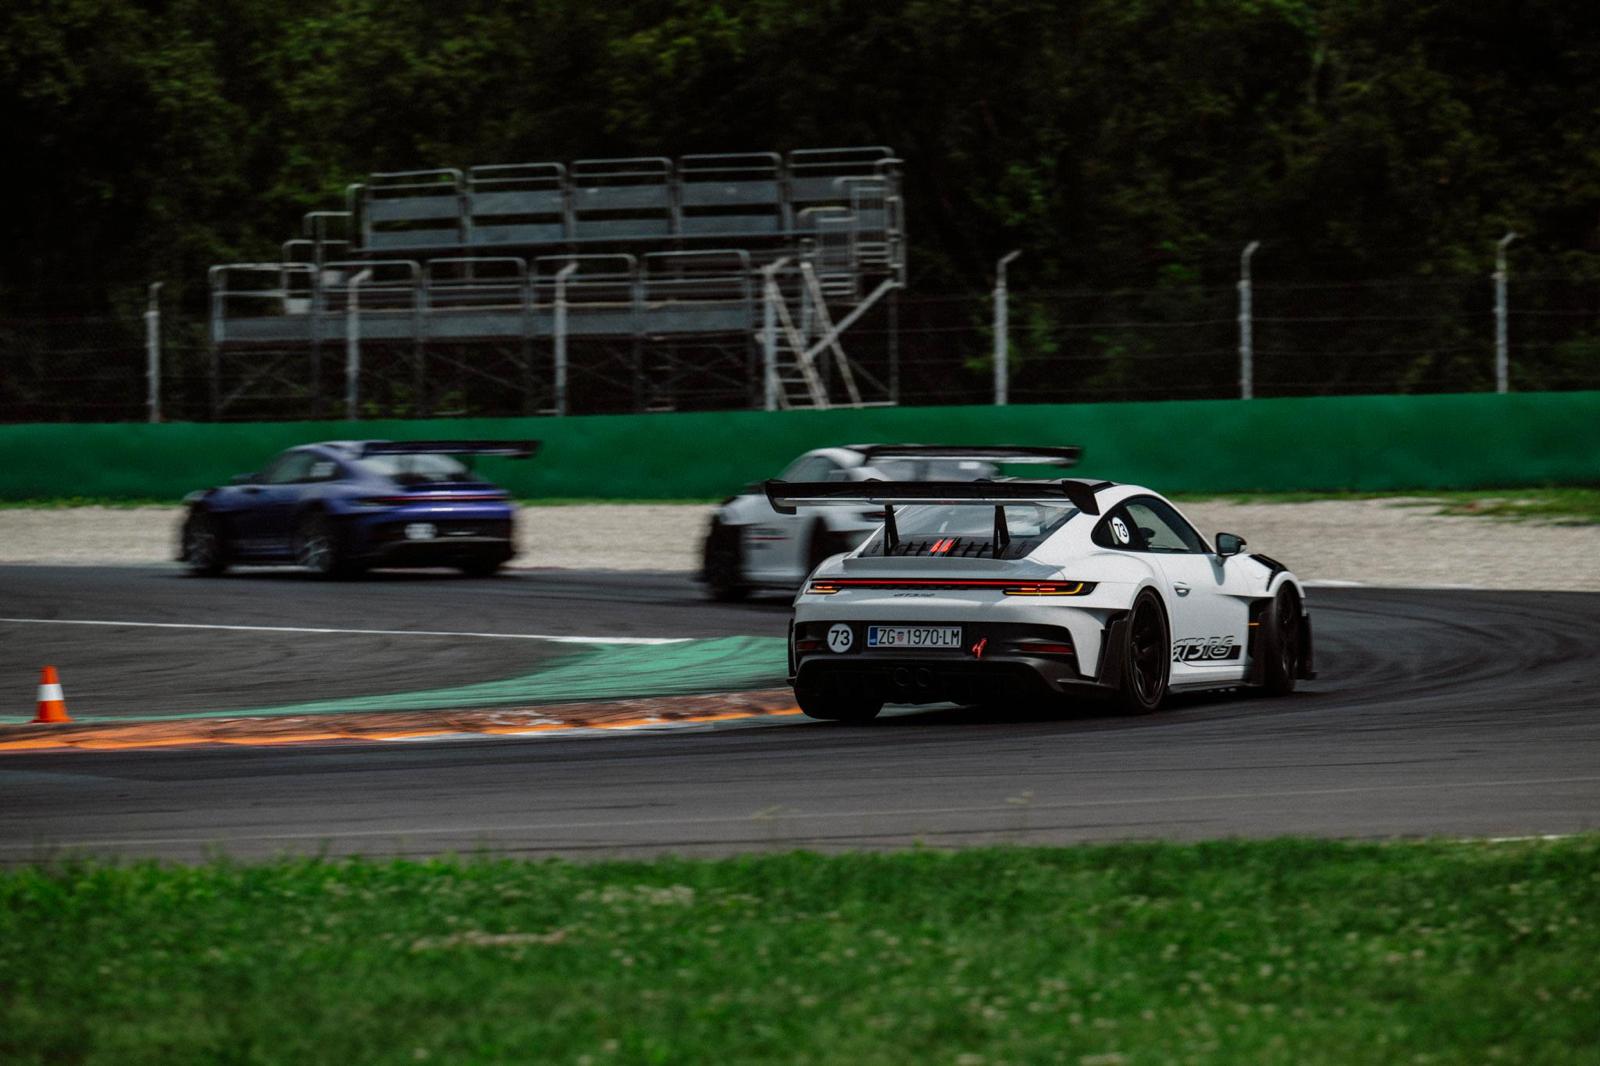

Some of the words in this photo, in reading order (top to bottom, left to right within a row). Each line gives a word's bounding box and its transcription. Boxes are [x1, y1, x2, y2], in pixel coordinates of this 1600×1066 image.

[1114, 523, 1128, 538] 73
[831, 629, 850, 646] 73
[878, 629, 895, 645] ZG
